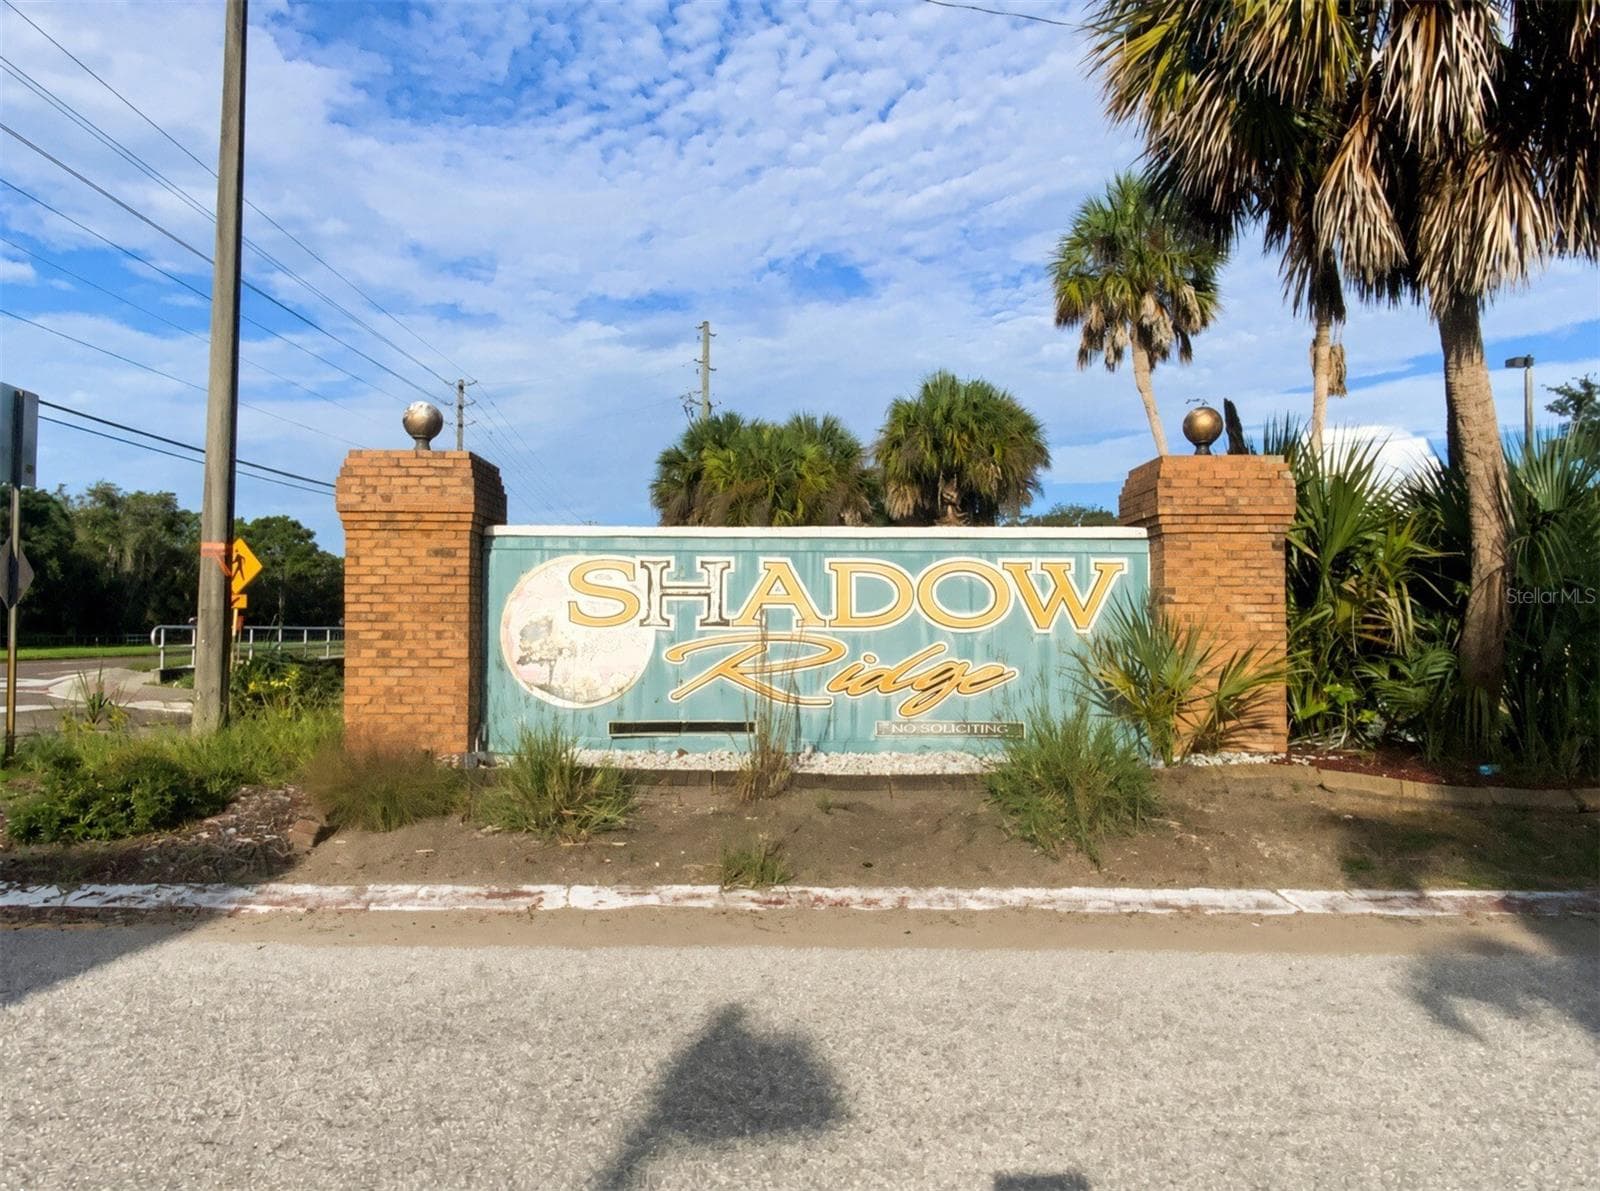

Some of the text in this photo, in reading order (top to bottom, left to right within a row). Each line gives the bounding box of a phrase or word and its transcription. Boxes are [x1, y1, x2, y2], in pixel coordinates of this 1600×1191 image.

[567, 558, 1125, 630] SHADOW
[665, 632, 1018, 717] Ridge
[891, 723, 1009, 735] NO SOLICITING
